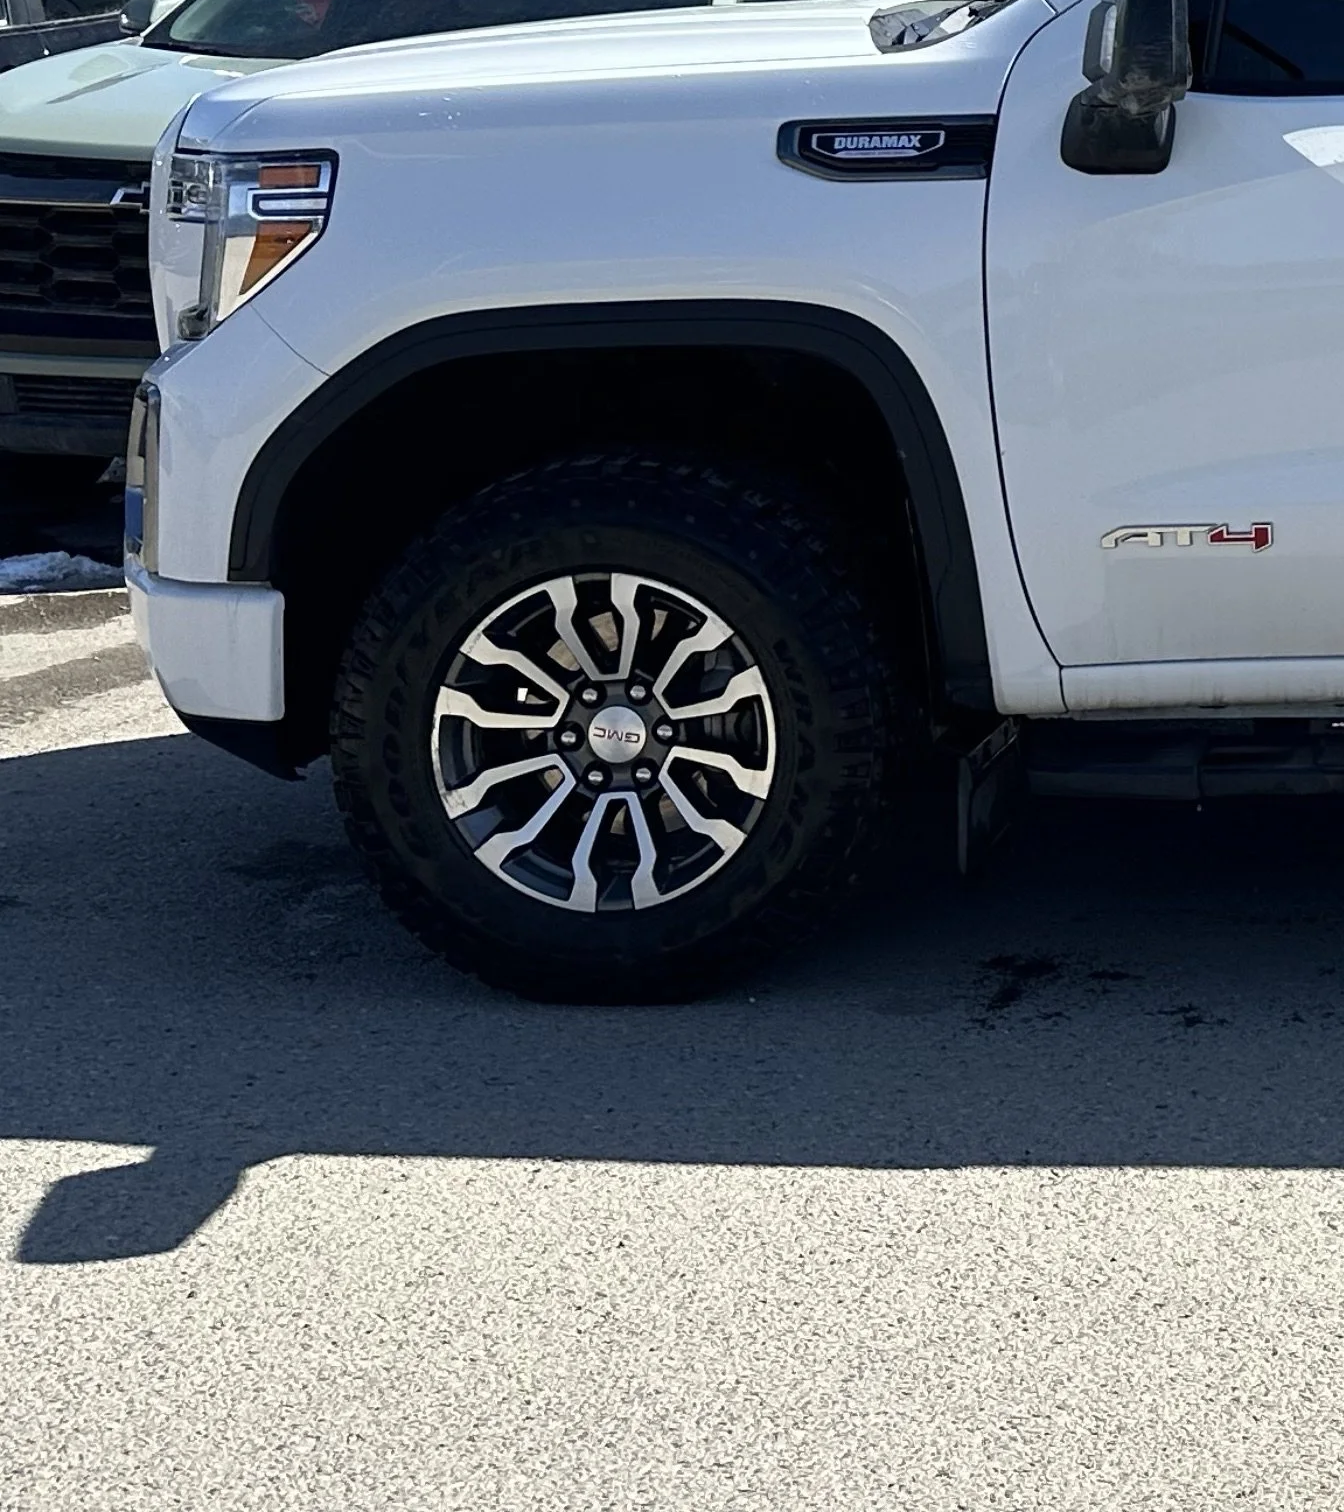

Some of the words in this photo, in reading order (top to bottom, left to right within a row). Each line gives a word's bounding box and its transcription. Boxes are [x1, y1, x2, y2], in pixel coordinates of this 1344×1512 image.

[834, 136, 921, 148] DURAMAX
[1100, 522, 1273, 553] AT4
[593, 727, 640, 743] GMC
